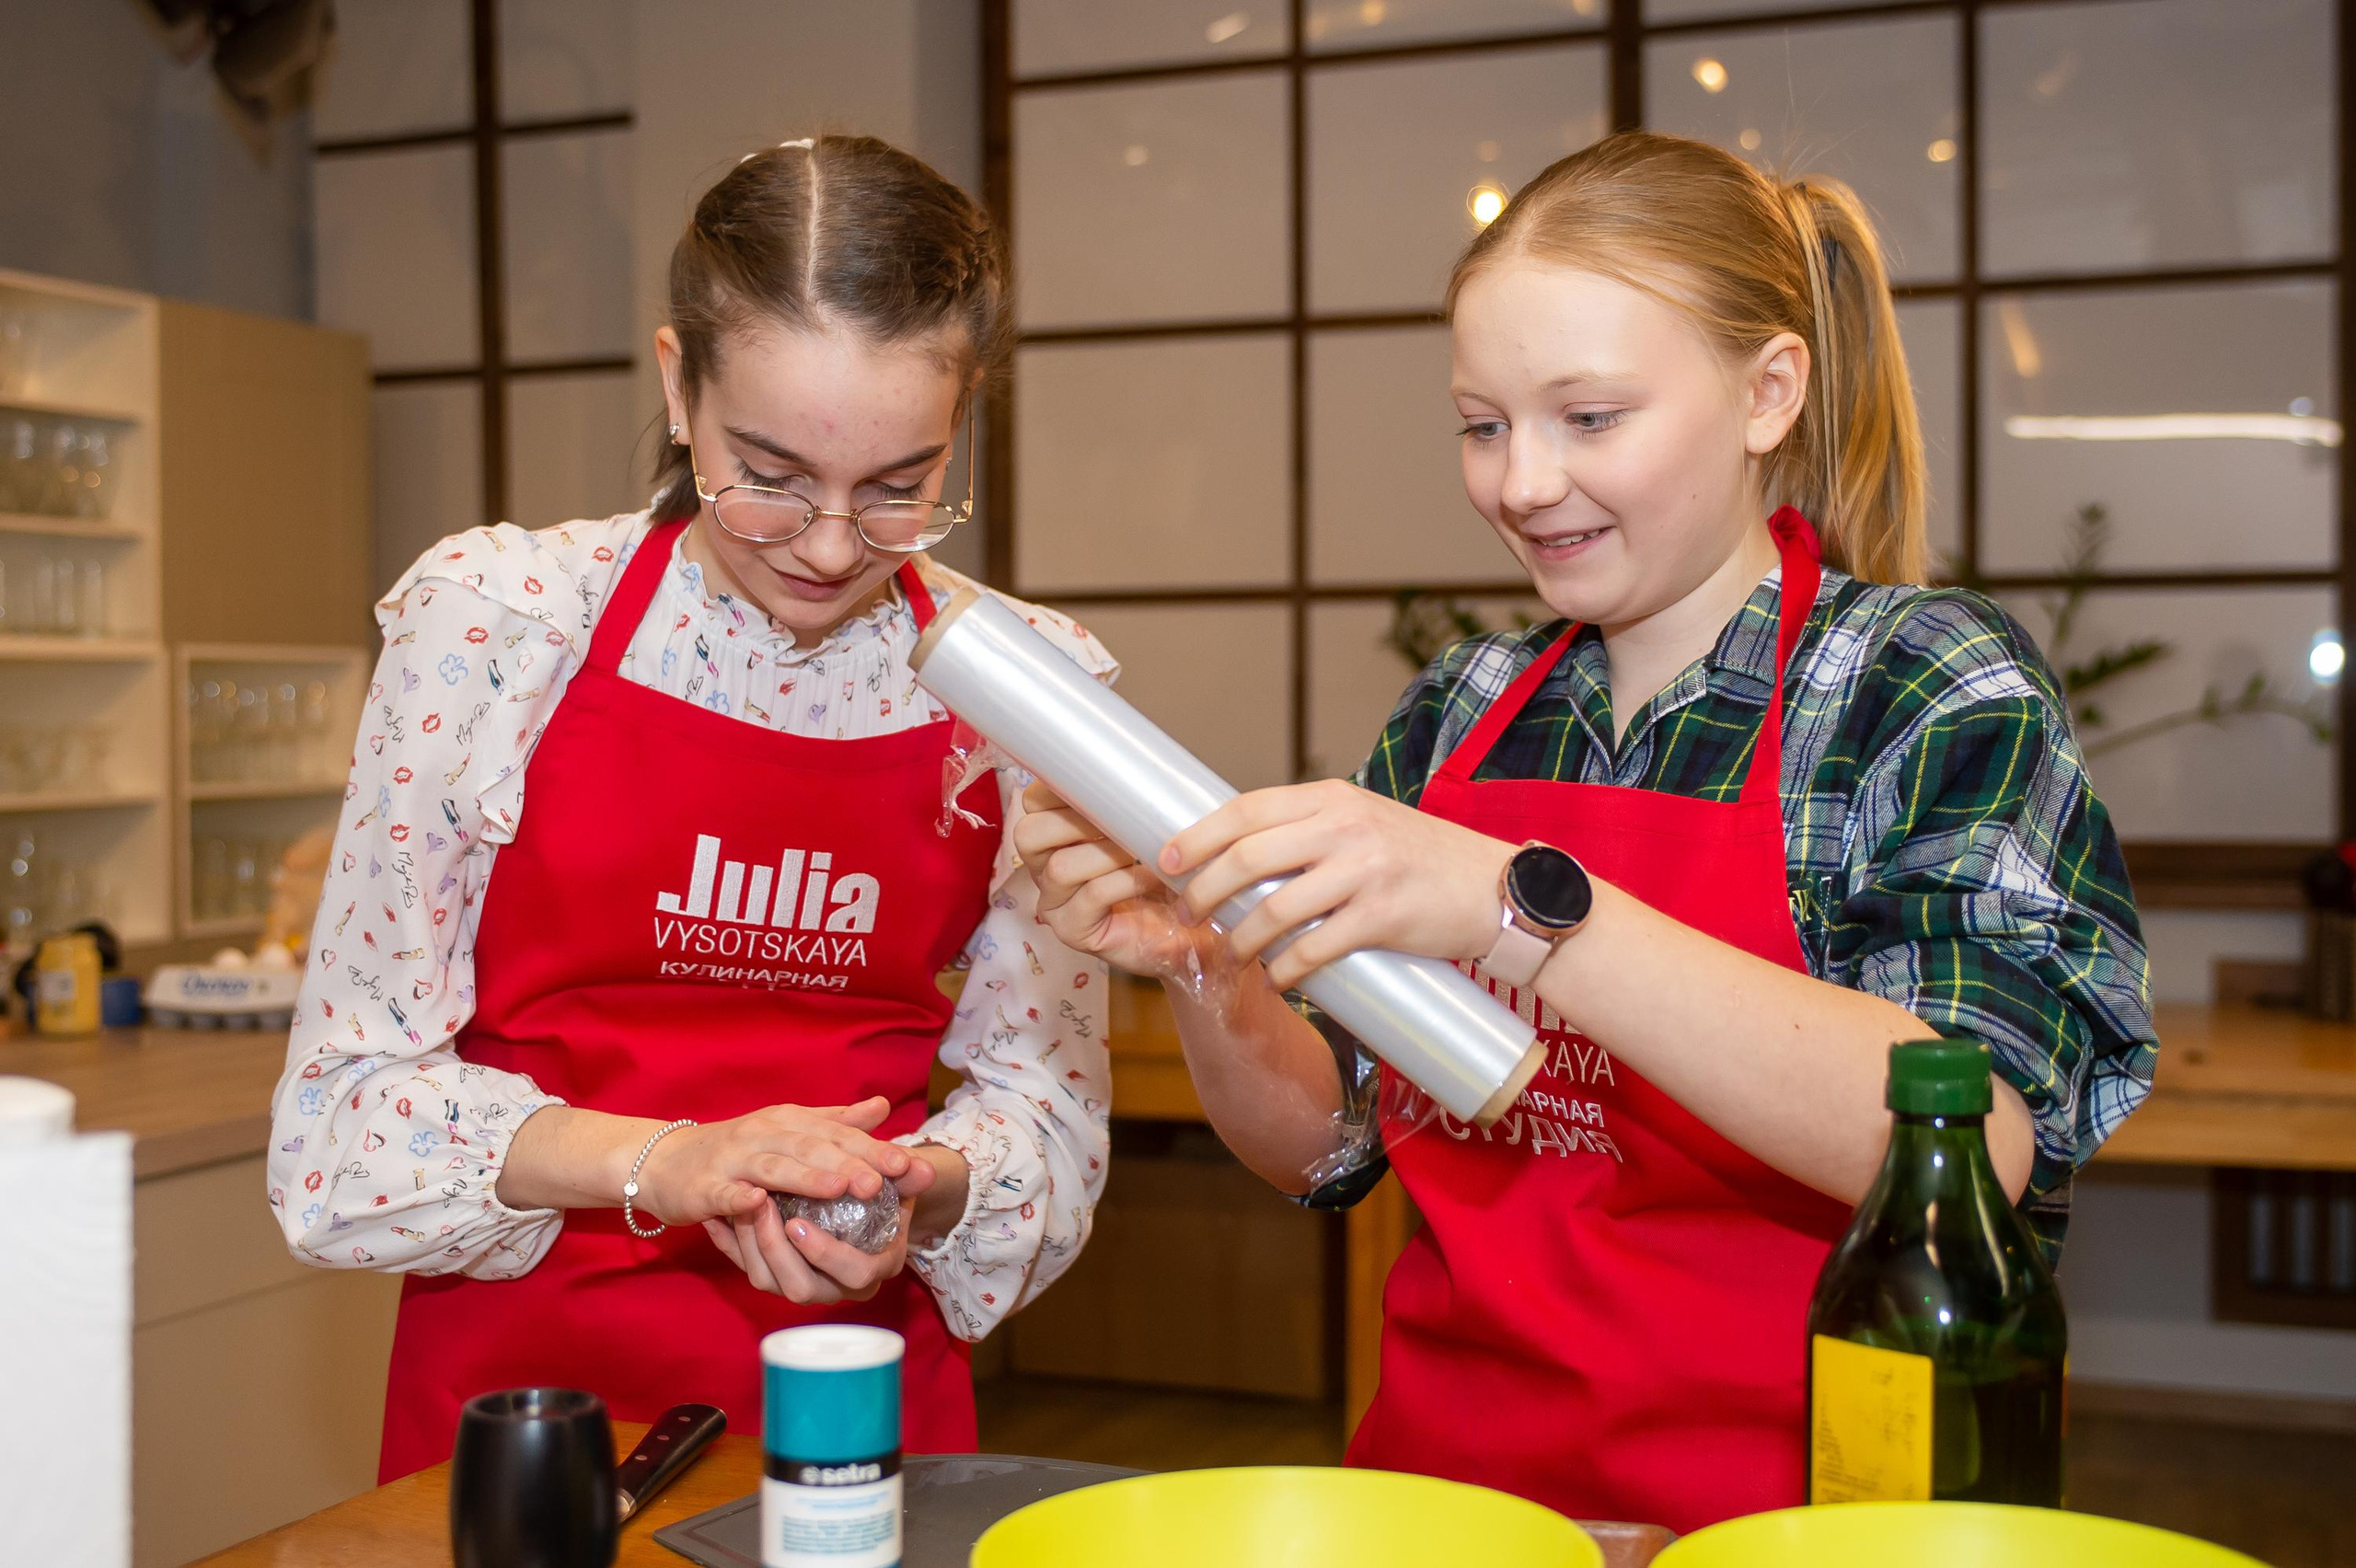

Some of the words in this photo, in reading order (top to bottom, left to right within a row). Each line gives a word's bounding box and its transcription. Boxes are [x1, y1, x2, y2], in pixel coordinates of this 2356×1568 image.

[655, 833, 881, 934] Julia
[653, 917, 867, 967] VYSOTSKAYA
[660, 961, 849, 989] КУЛИНАРНАЯ
